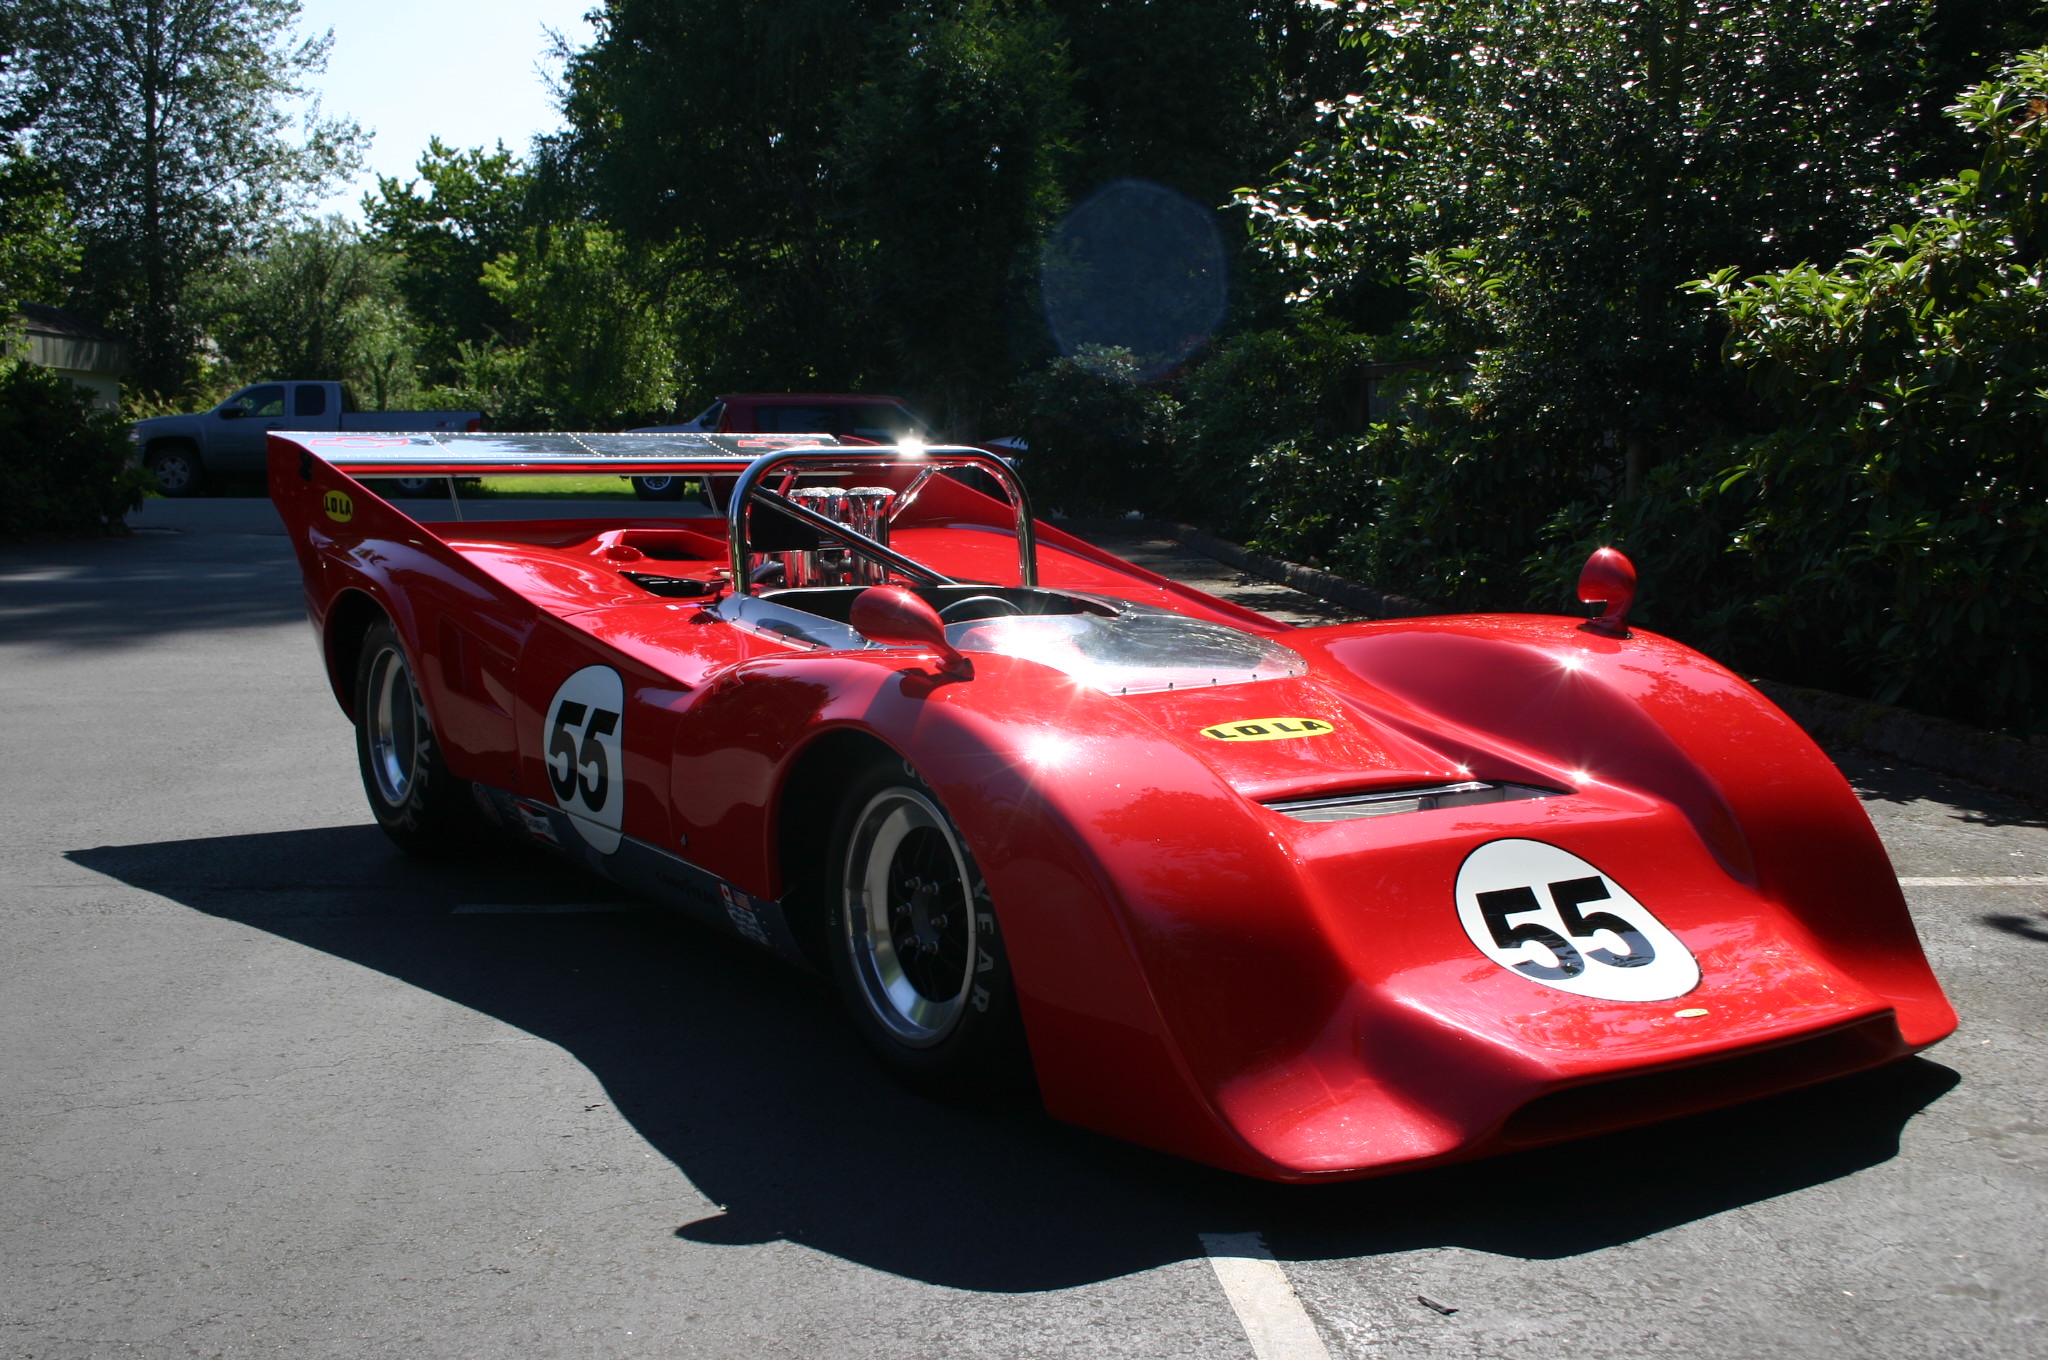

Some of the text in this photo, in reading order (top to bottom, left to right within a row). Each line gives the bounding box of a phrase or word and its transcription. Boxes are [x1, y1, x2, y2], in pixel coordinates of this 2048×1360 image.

[324, 496, 352, 516] LOLA
[548, 699, 620, 813] 55
[1205, 720, 1332, 739] LOLA
[1475, 875, 1656, 981] 55
